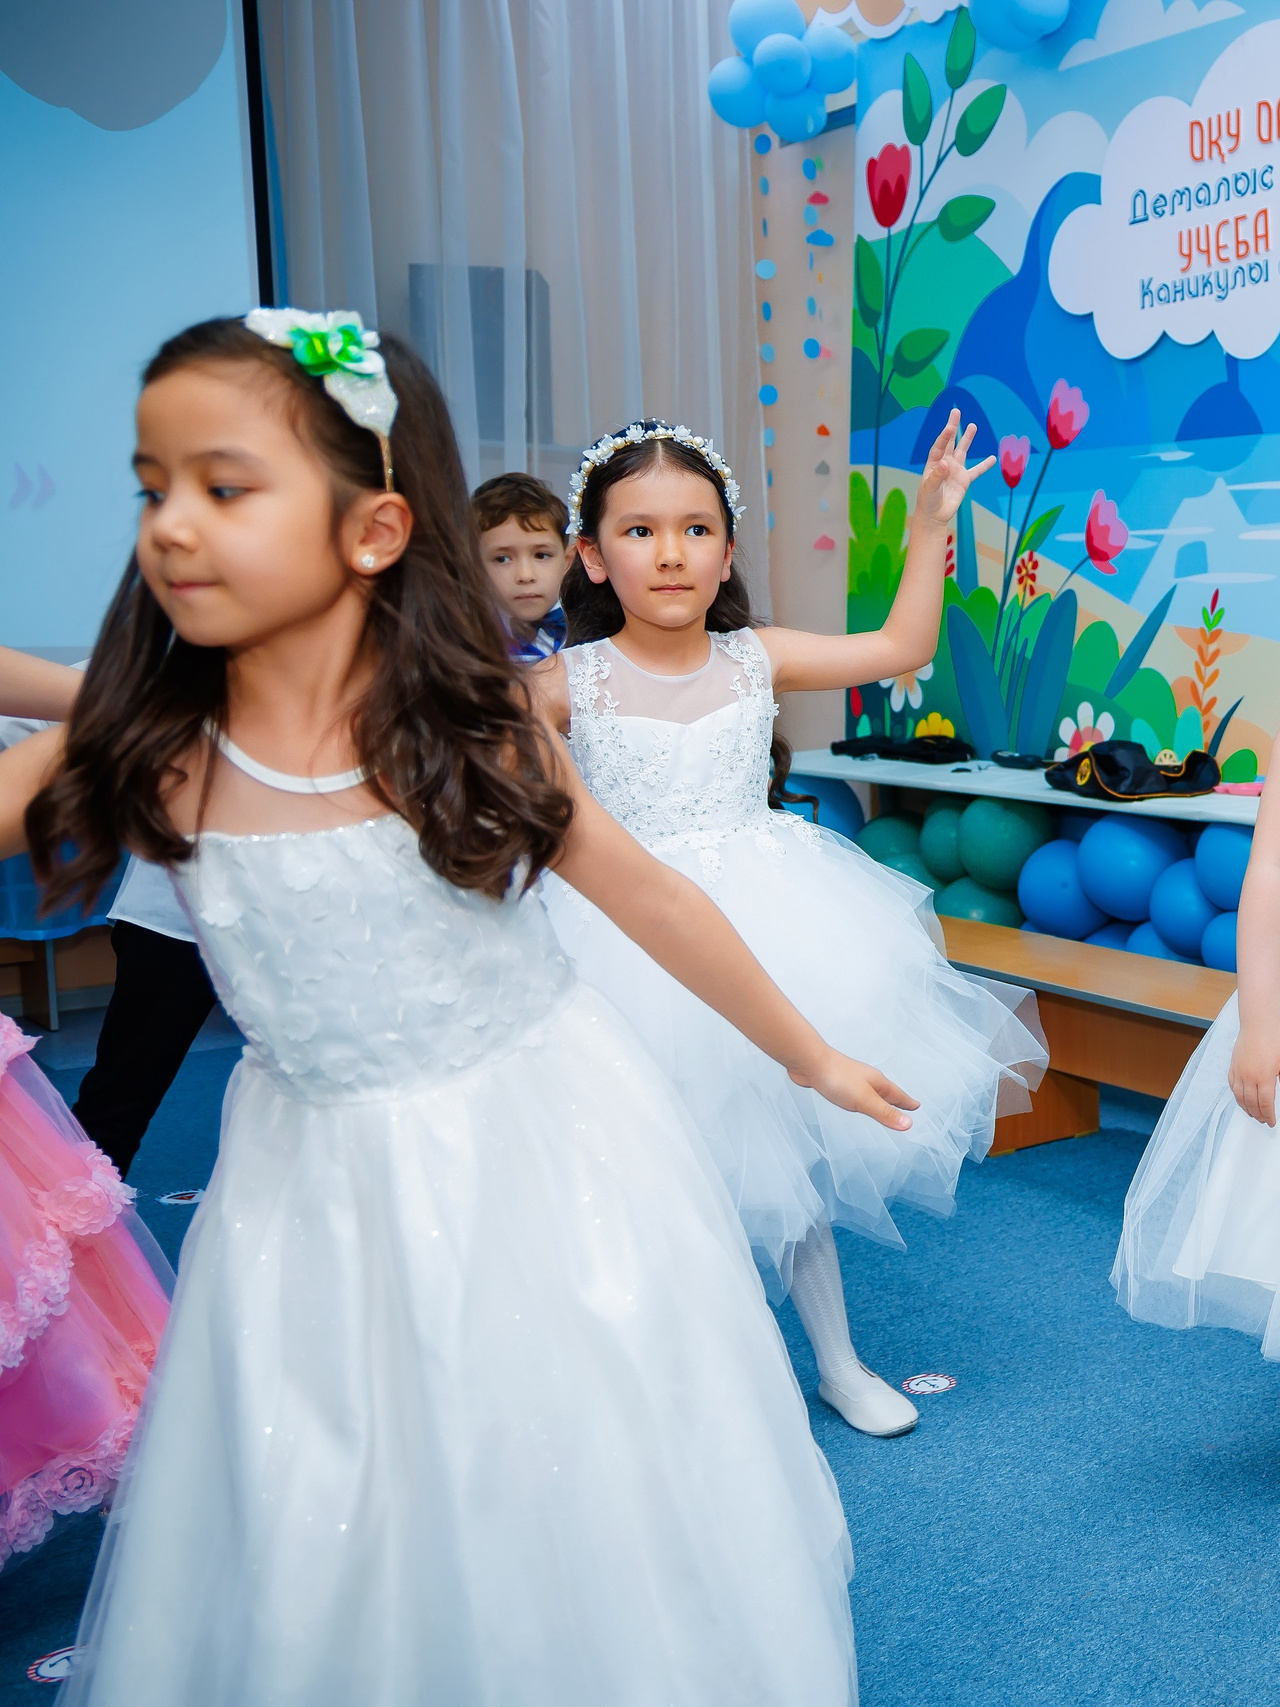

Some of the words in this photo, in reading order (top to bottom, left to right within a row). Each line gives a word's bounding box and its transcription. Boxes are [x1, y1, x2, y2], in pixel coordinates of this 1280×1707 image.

[1189, 107, 1241, 163] ОҚУ
[1129, 164, 1274, 225] Демалыс
[1178, 207, 1271, 273] УЧЕБА
[1139, 259, 1270, 309] Каникулы
